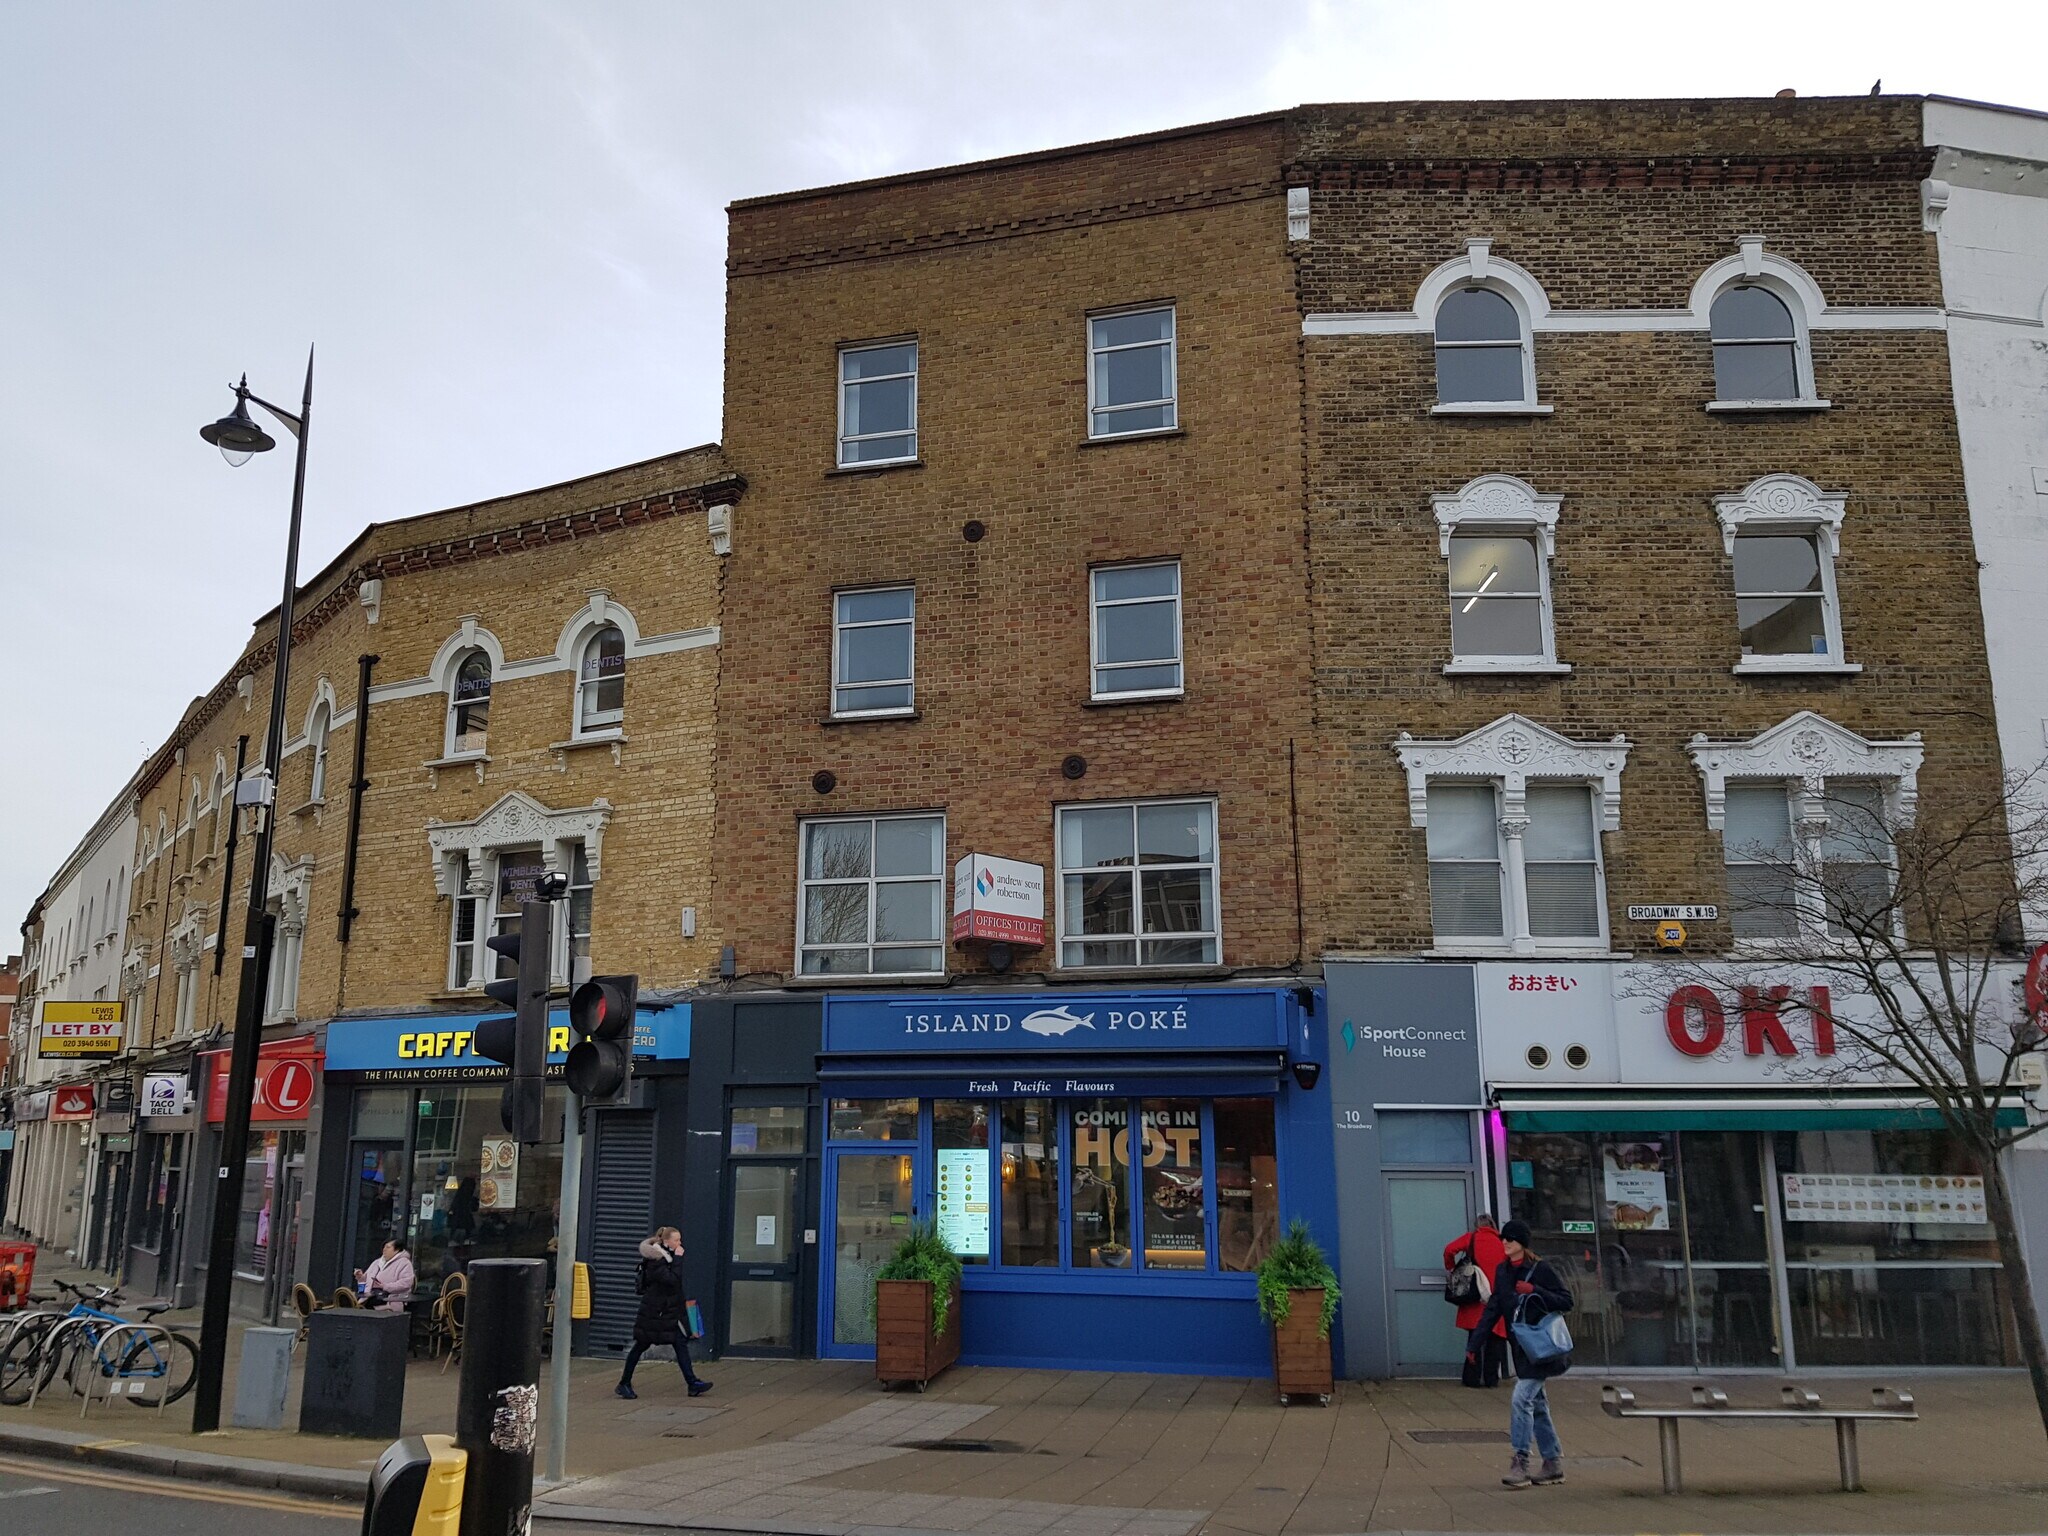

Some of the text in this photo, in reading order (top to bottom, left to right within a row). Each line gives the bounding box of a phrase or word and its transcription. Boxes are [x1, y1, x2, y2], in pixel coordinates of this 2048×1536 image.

[457, 678, 490, 693] DENTIS
[510, 879, 536, 890] DENT
[997, 874, 1041, 890] andrew scott
[997, 887, 1030, 901] robertson
[1631, 907, 1680, 918] BROADWAY
[976, 915, 1012, 929] OFFICES
[1013, 920, 1026, 932] TO
[1027, 923, 1042, 934] LET
[1665, 930, 1680, 939] ADT
[1508, 974, 1578, 992] おおきい
[91, 1007, 114, 1015] LEWIS
[905, 1004, 1188, 1033] ISLAND POKÉ
[1664, 984, 1837, 1057] OKI
[52, 1024, 113, 1035] LET BY
[633, 1025, 652, 1034] AFFÈ
[1360, 1026, 1466, 1042] iSportConnect
[398, 1031, 480, 1058] CAFF
[633, 1036, 656, 1047] ERO
[1383, 1045, 1427, 1058] House
[365, 1067, 511, 1080] THE ITALIAN COFFEE COMPANY
[969, 1080, 1115, 1092] Fresh Pacific Flavours
[149, 1100, 175, 1108] TACO
[1075, 1111, 1197, 1126] COMING IN
[1345, 1110, 1360, 1122] 10
[1075, 1127, 1200, 1167] HOT
